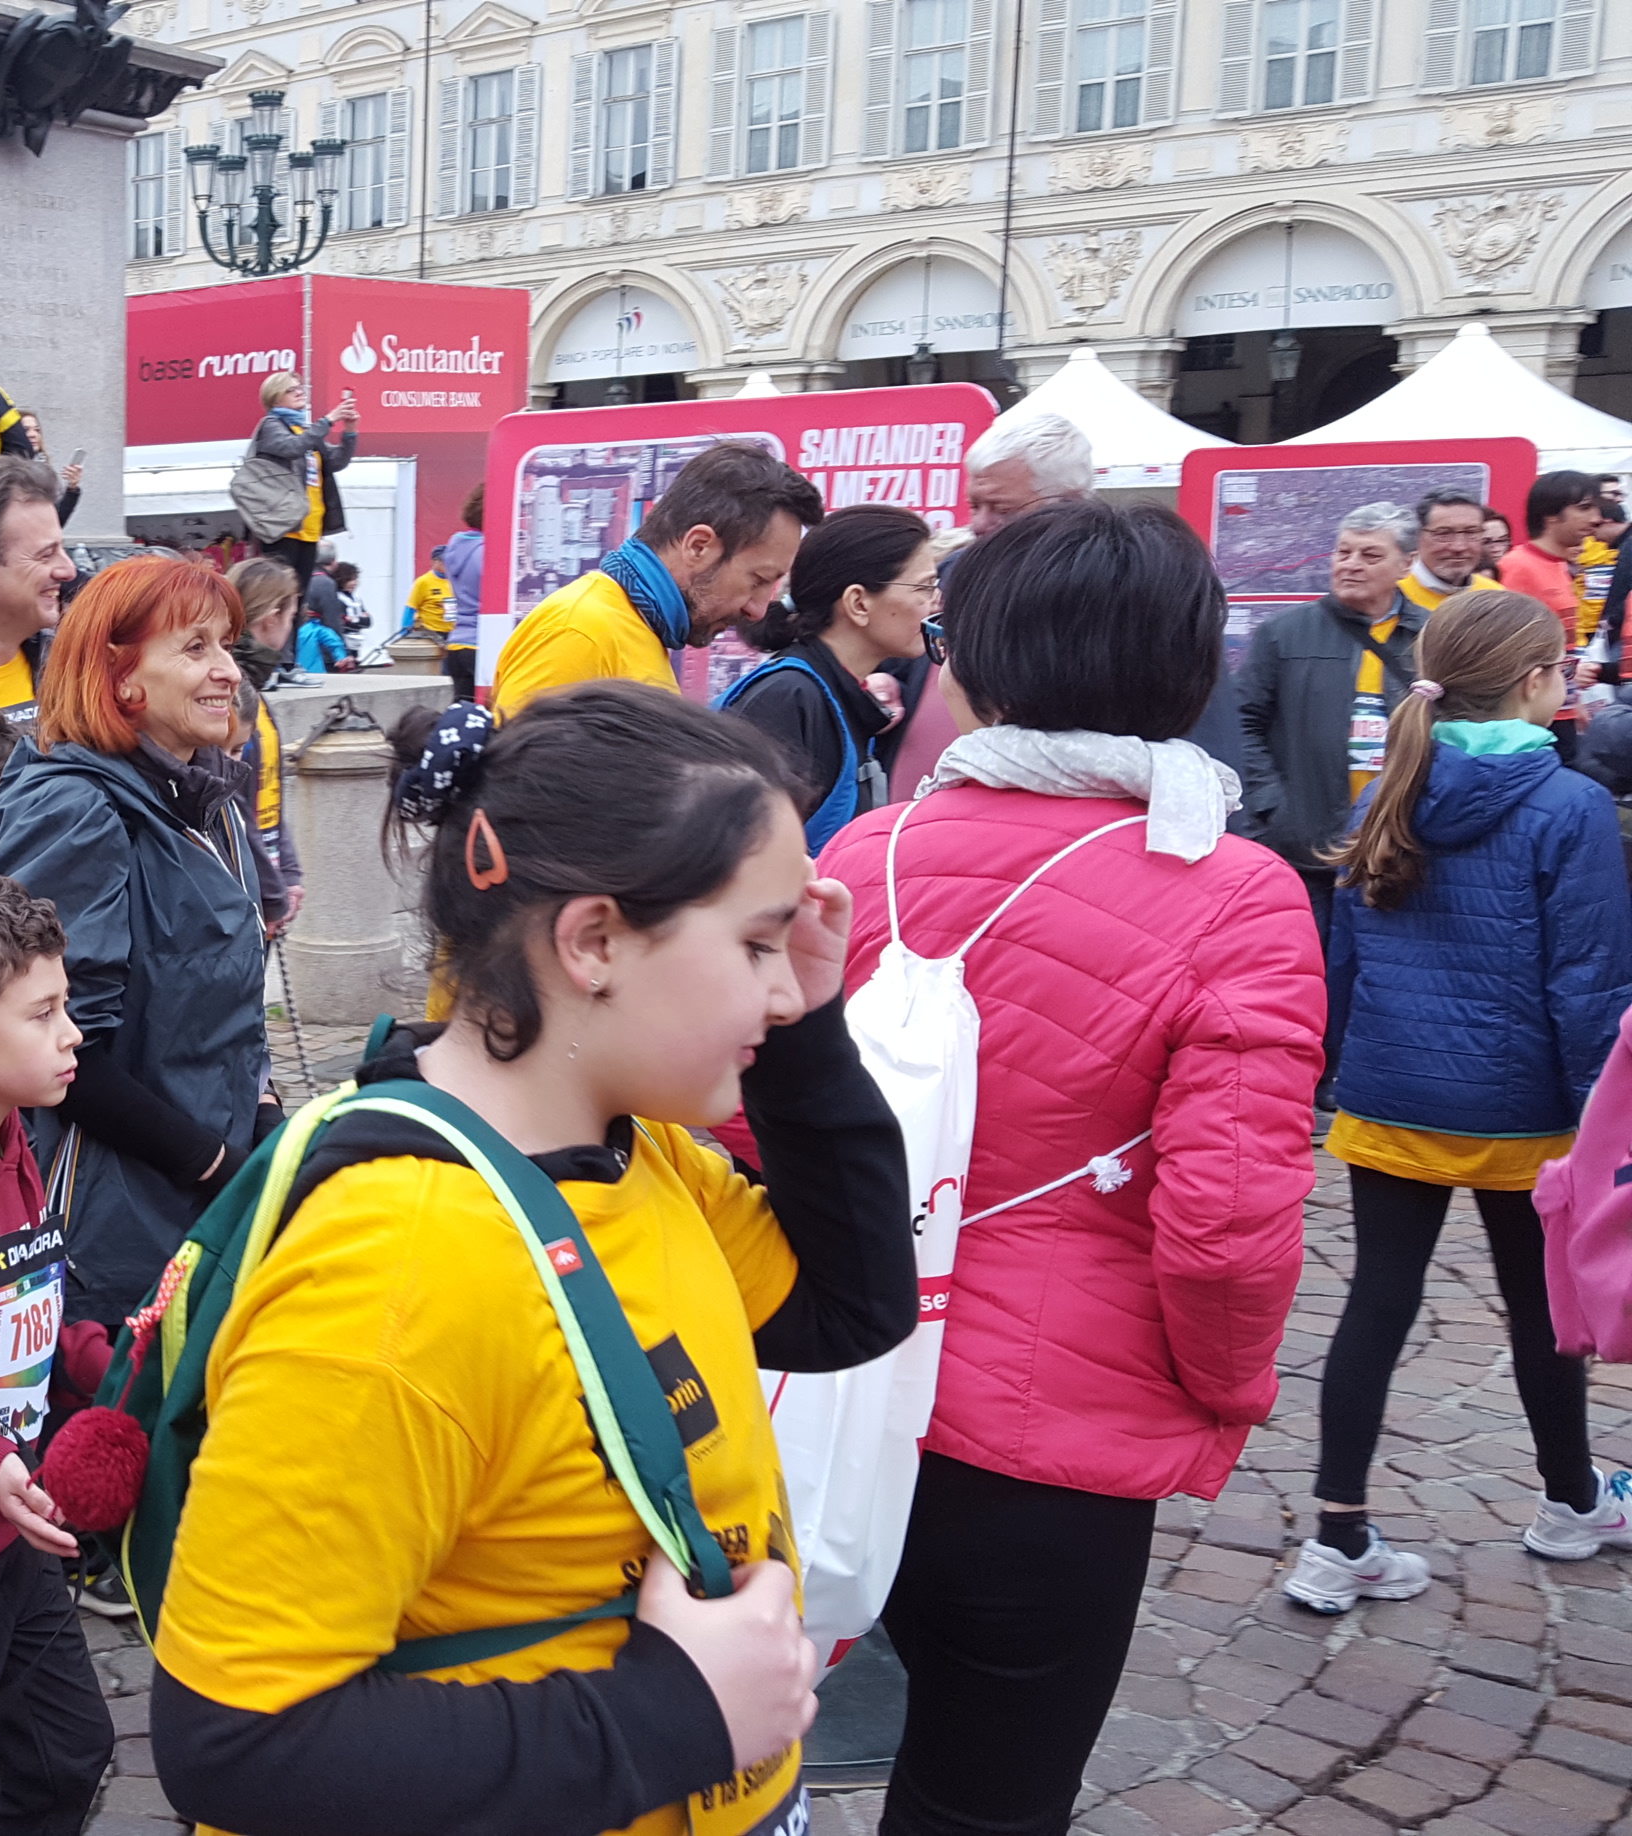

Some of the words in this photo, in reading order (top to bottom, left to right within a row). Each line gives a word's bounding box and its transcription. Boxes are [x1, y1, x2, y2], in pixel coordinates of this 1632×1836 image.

[1194, 291, 1259, 311] INTESA
[1293, 282, 1394, 304] SANPAOLO
[851, 319, 906, 338] INTESA
[139, 354, 193, 382] base
[198, 349, 296, 378] running
[381, 334, 505, 375] Santander
[381, 390, 444, 408] CONSUMER
[448, 391, 481, 408] BANK
[798, 422, 966, 468] SANTANDER
[830, 469, 922, 508] MEZZA
[926, 469, 960, 507] DI
[10, 1298, 54, 1362] 7183
[665, 1378, 703, 1415] orin
